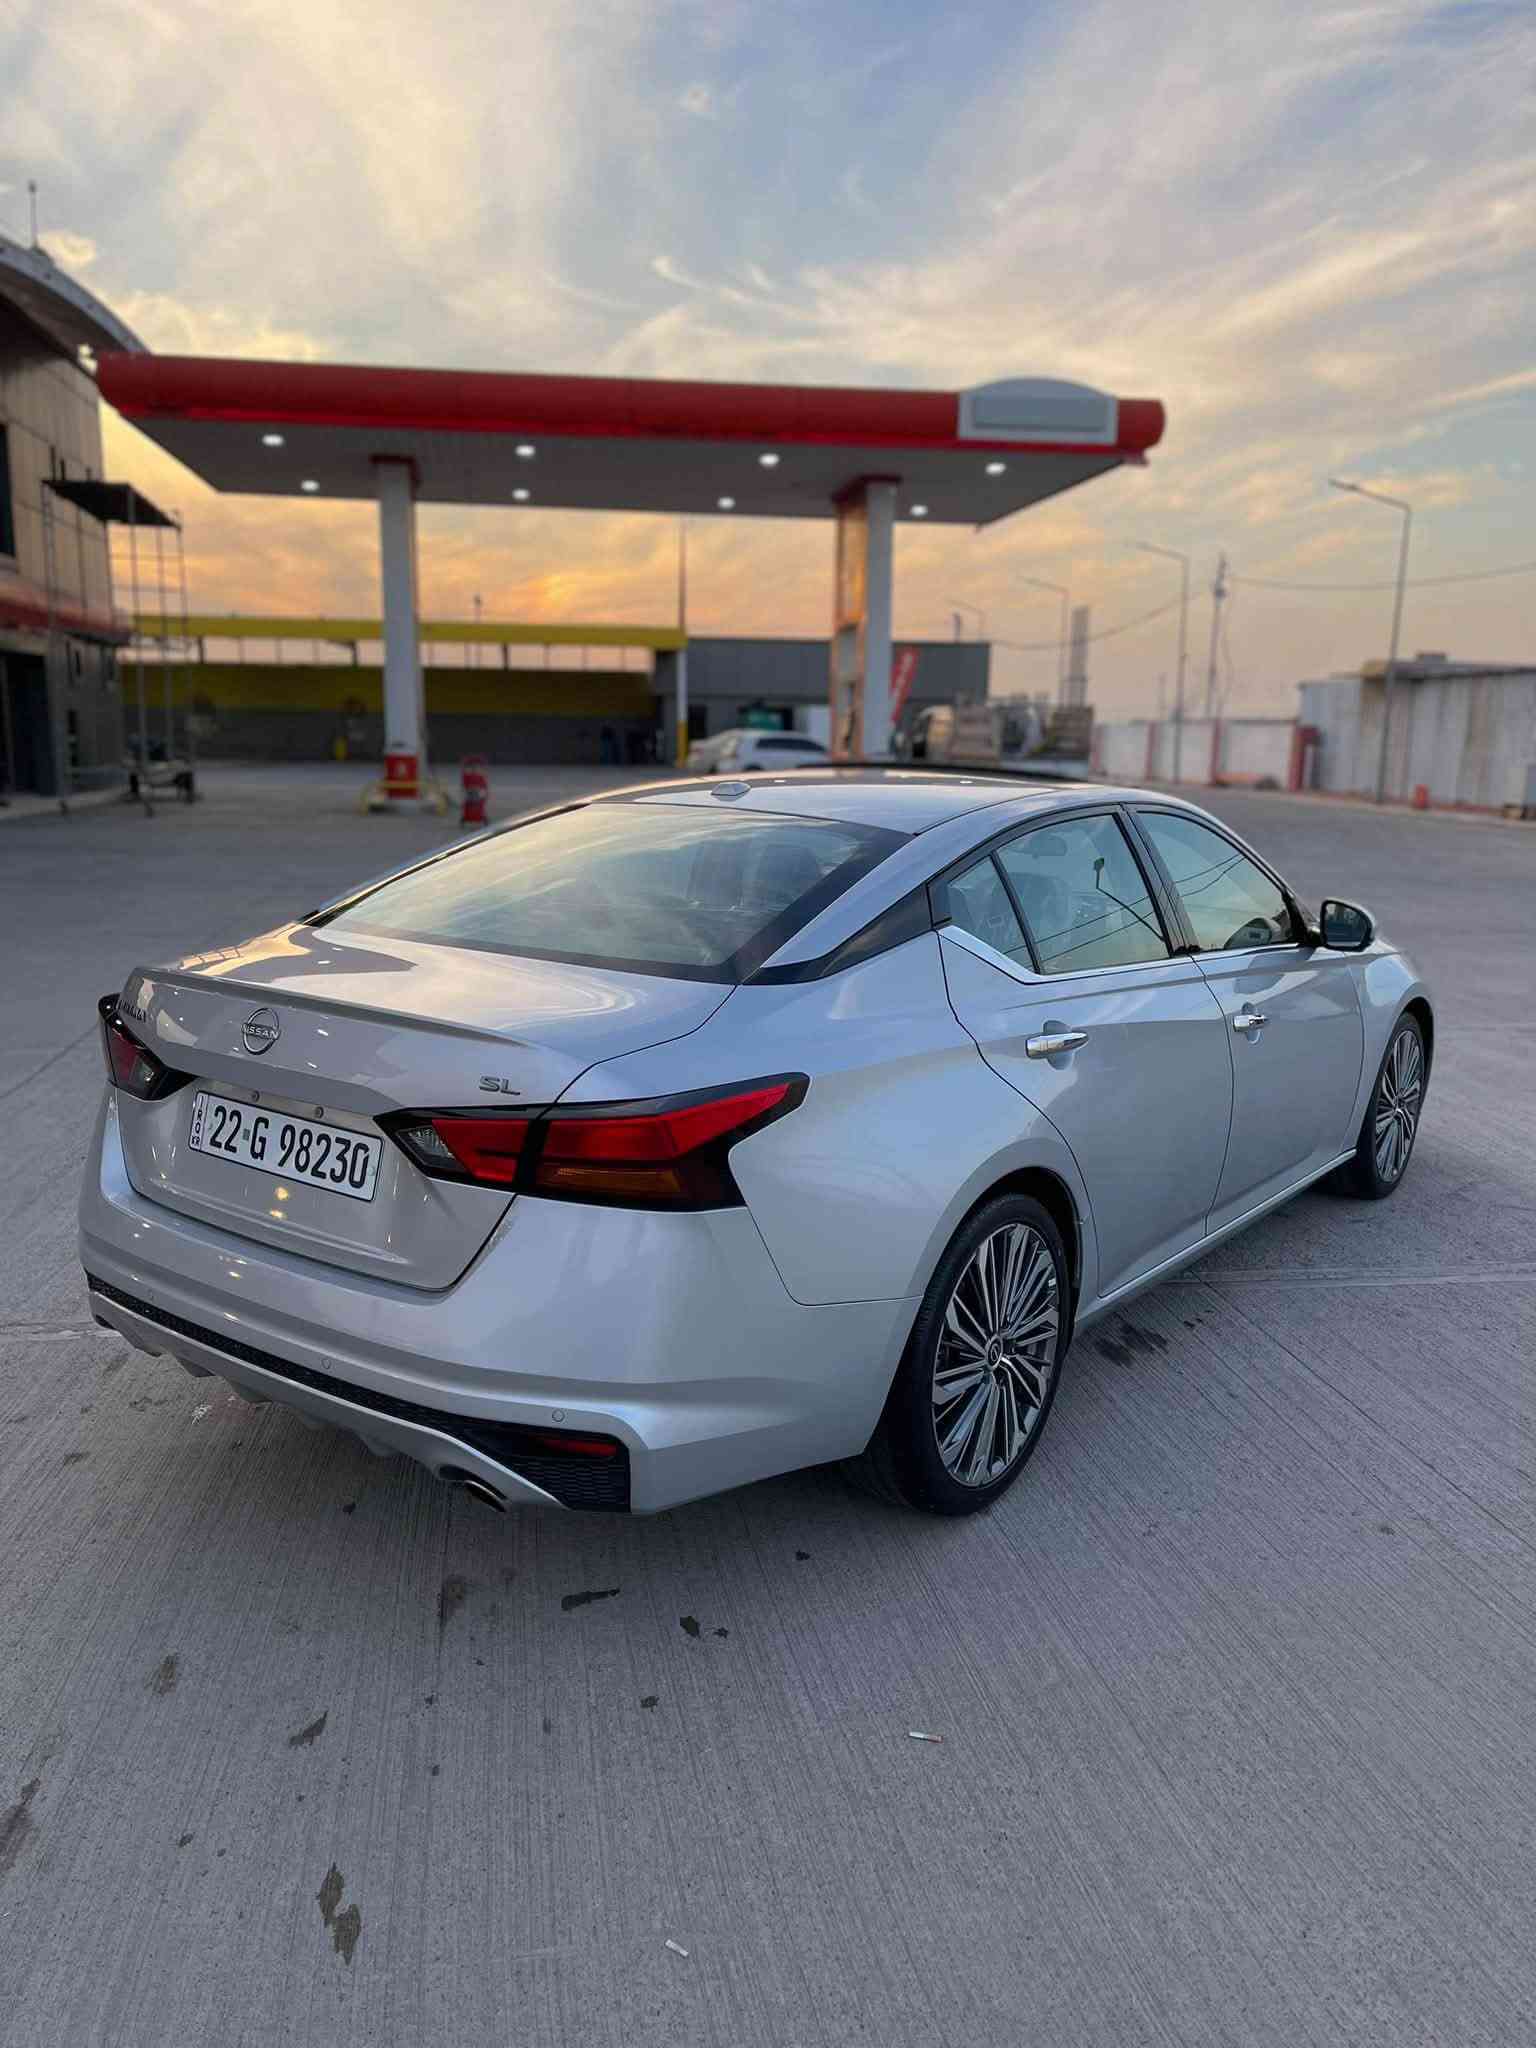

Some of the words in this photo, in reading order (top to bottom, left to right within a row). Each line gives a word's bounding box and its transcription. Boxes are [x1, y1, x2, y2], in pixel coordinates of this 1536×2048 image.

[479, 1075, 521, 1096] SL
[209, 1105, 242, 1153] 22
[250, 1116, 270, 1161] G
[278, 1124, 370, 1189] 98230
